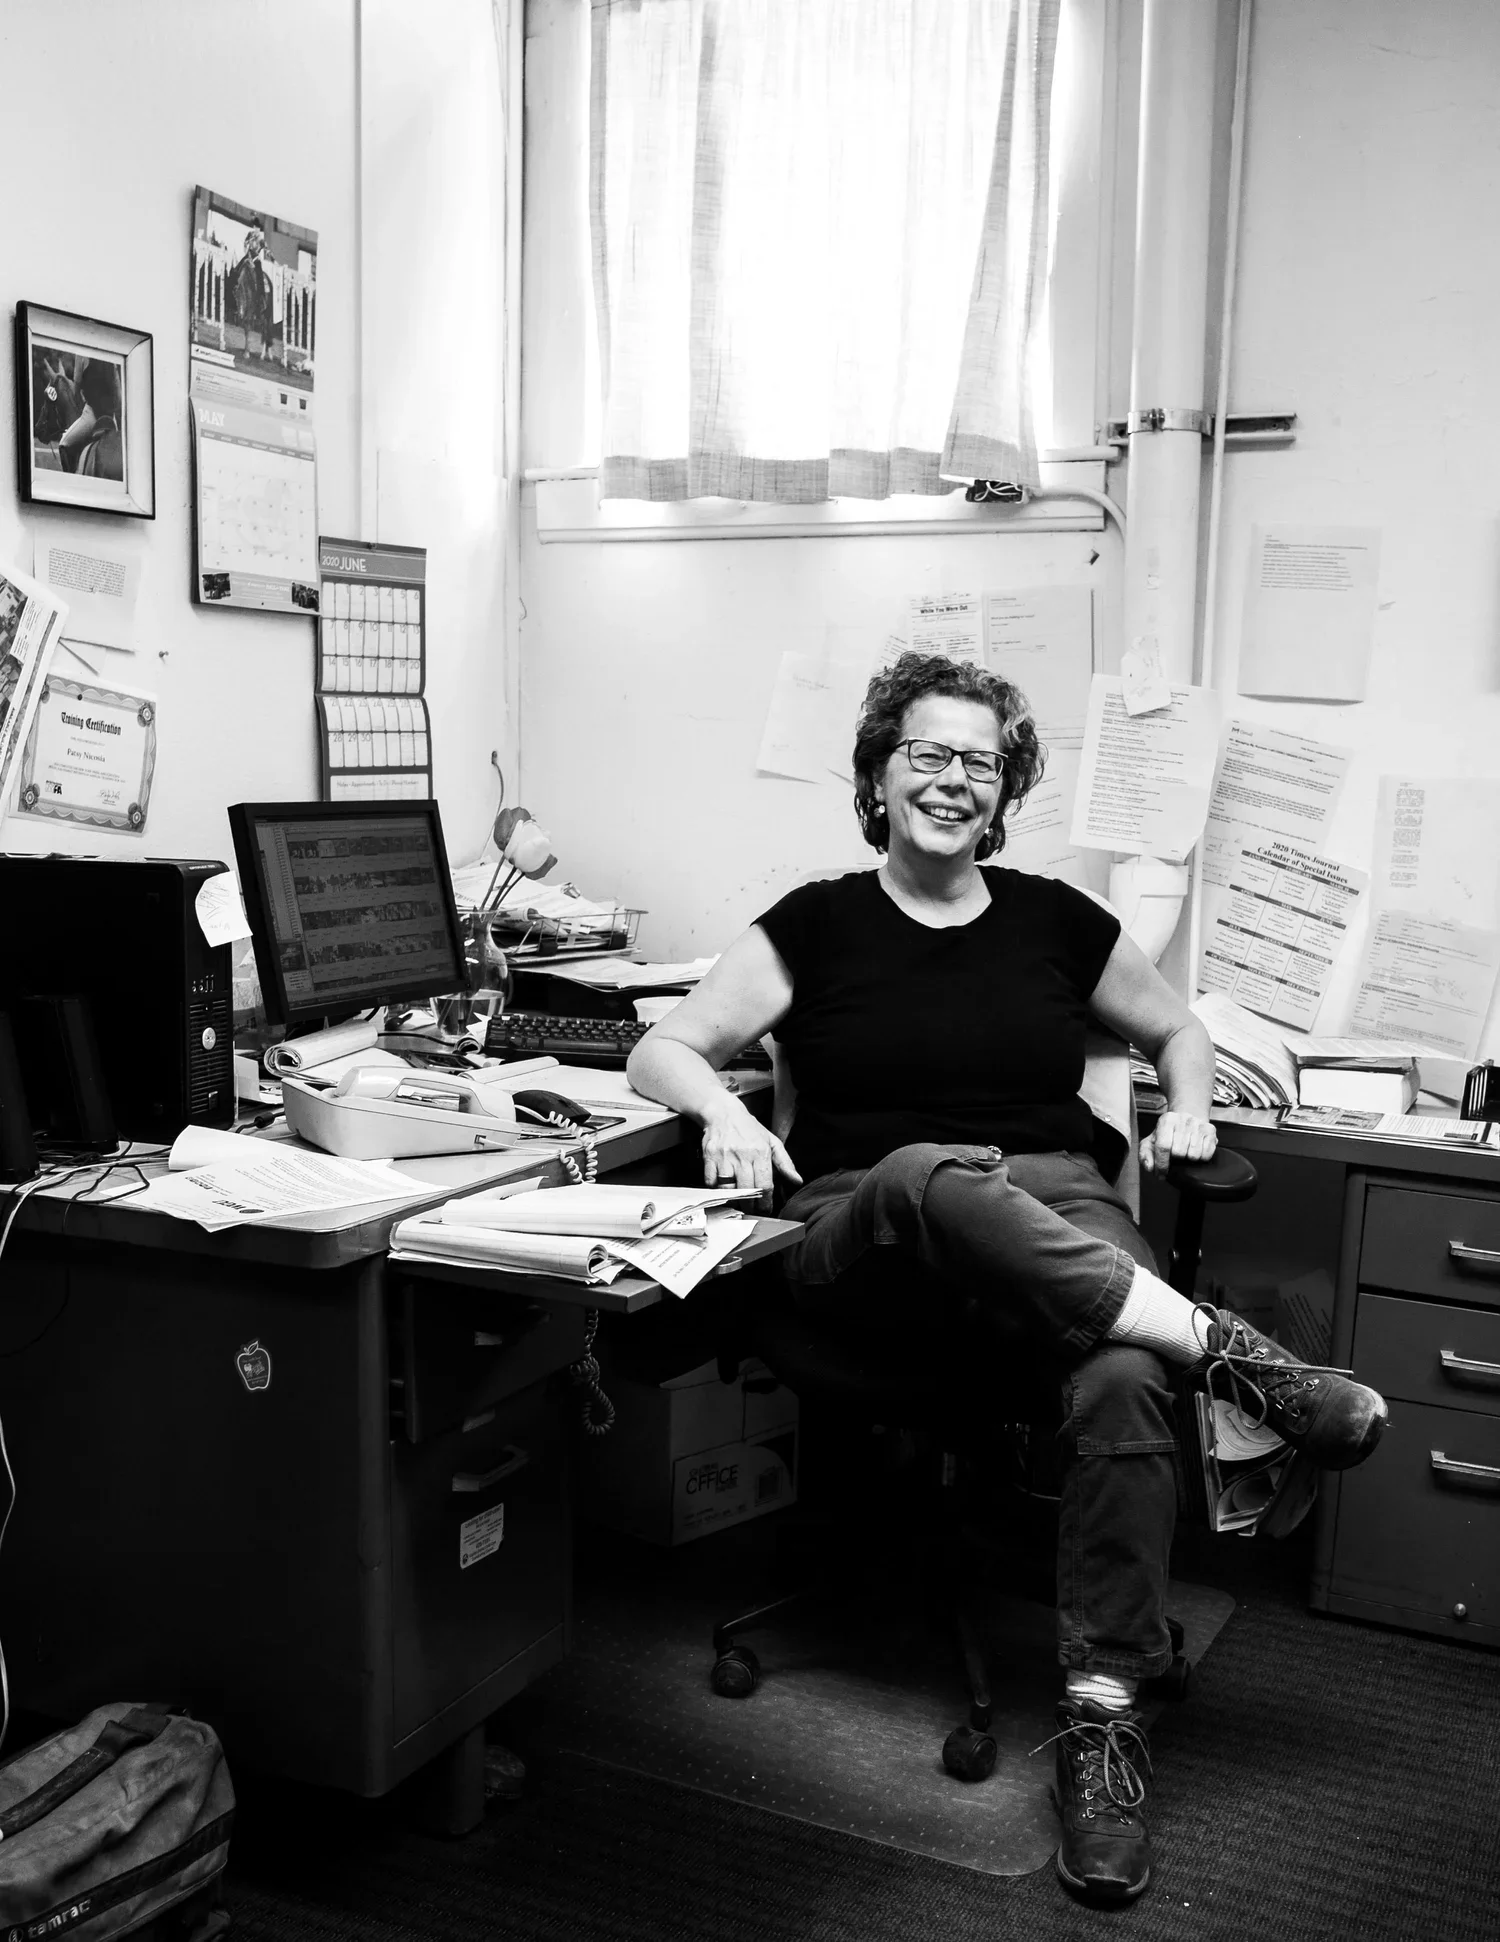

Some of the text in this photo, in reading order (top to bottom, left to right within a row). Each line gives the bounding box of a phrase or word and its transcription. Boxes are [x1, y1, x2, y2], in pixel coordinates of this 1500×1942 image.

[198, 408, 225, 426] MAY
[322, 556, 366, 572] 2020 JUNE
[359, 587, 364, 596] 2
[387, 589, 392, 597] 4
[414, 592, 419, 600] 6
[328, 658, 336, 666] 14
[342, 658, 349, 666] 15
[385, 660, 392, 668] 18
[410, 661, 419, 669] 20
[61, 712, 122, 735] Training Certification
[334, 733, 371, 742] 28 29 30
[67, 748, 105, 762] Patsy Nicosia
[1257, 846, 1348, 884] Calendar of Special Issues
[1272, 842, 1340, 872] 2020 Times Journal
[28, 1898, 91, 1940] tamrac
